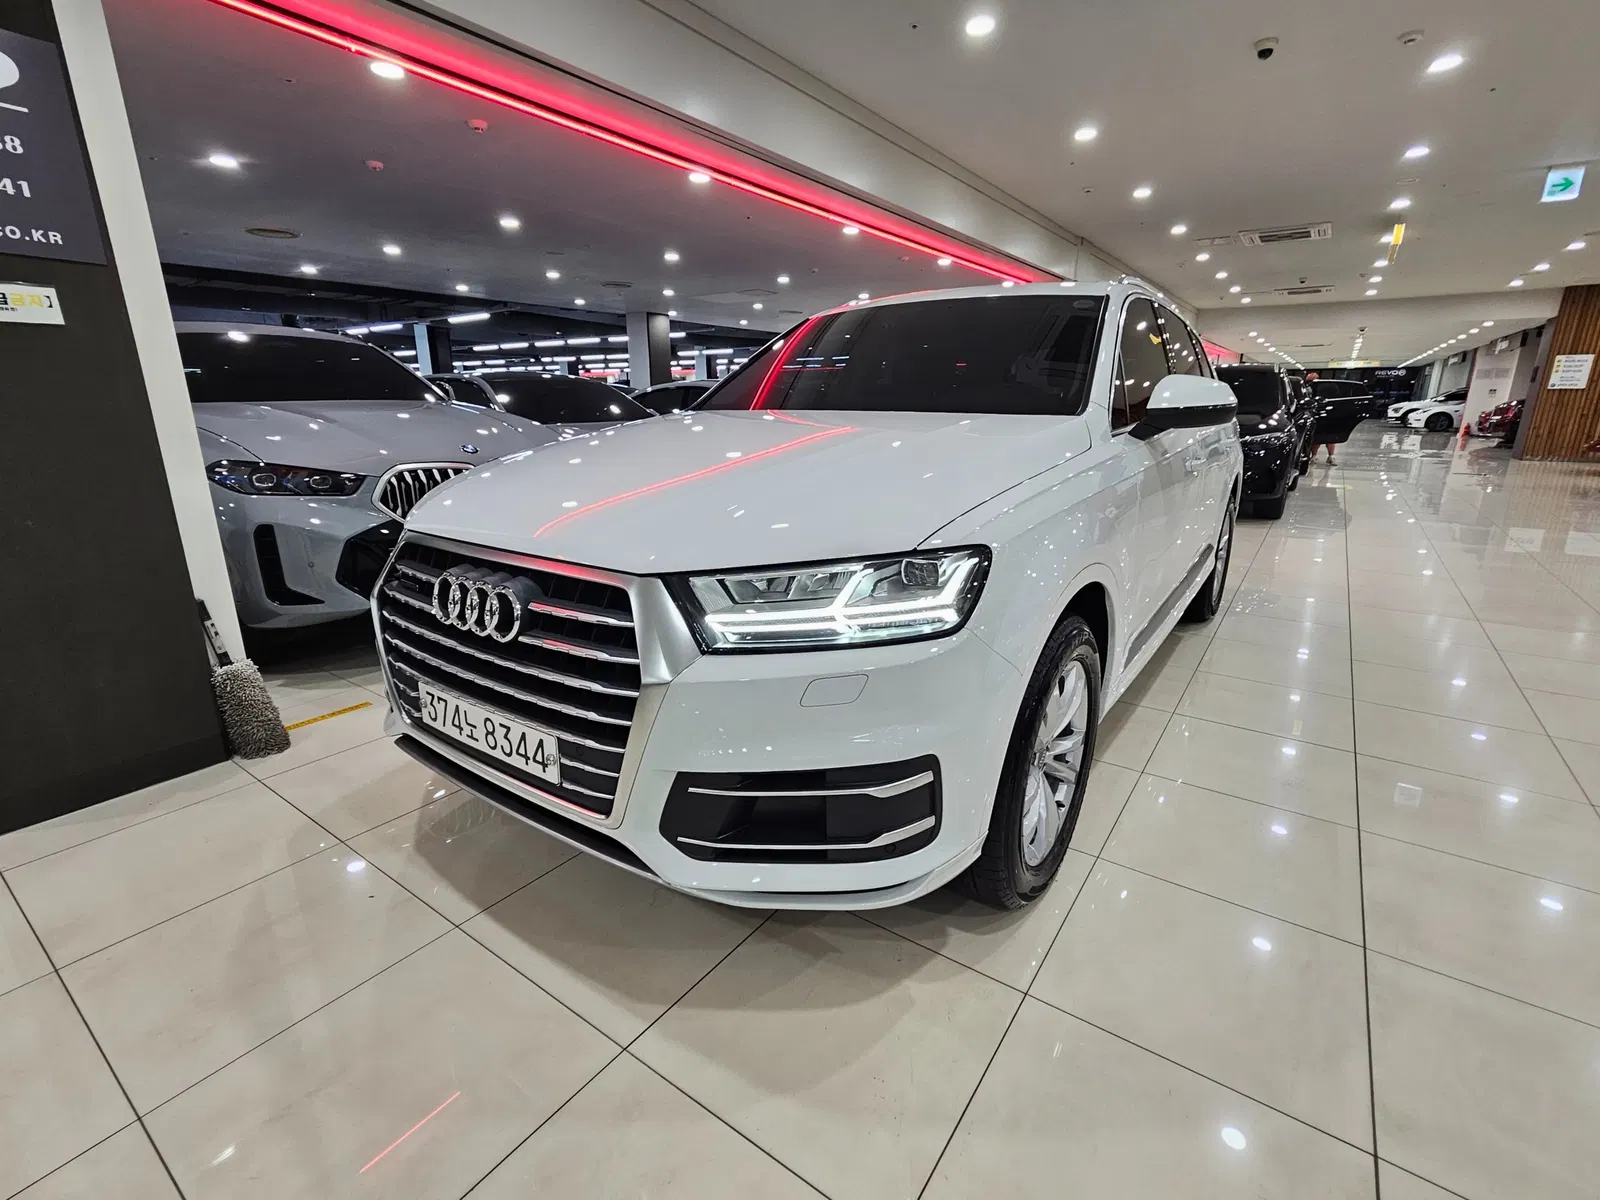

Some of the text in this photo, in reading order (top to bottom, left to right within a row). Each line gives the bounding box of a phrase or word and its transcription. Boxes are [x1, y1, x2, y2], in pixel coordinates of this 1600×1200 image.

[0, 135, 24, 154] 8
[425, 690, 549, 774] 374노 8344
